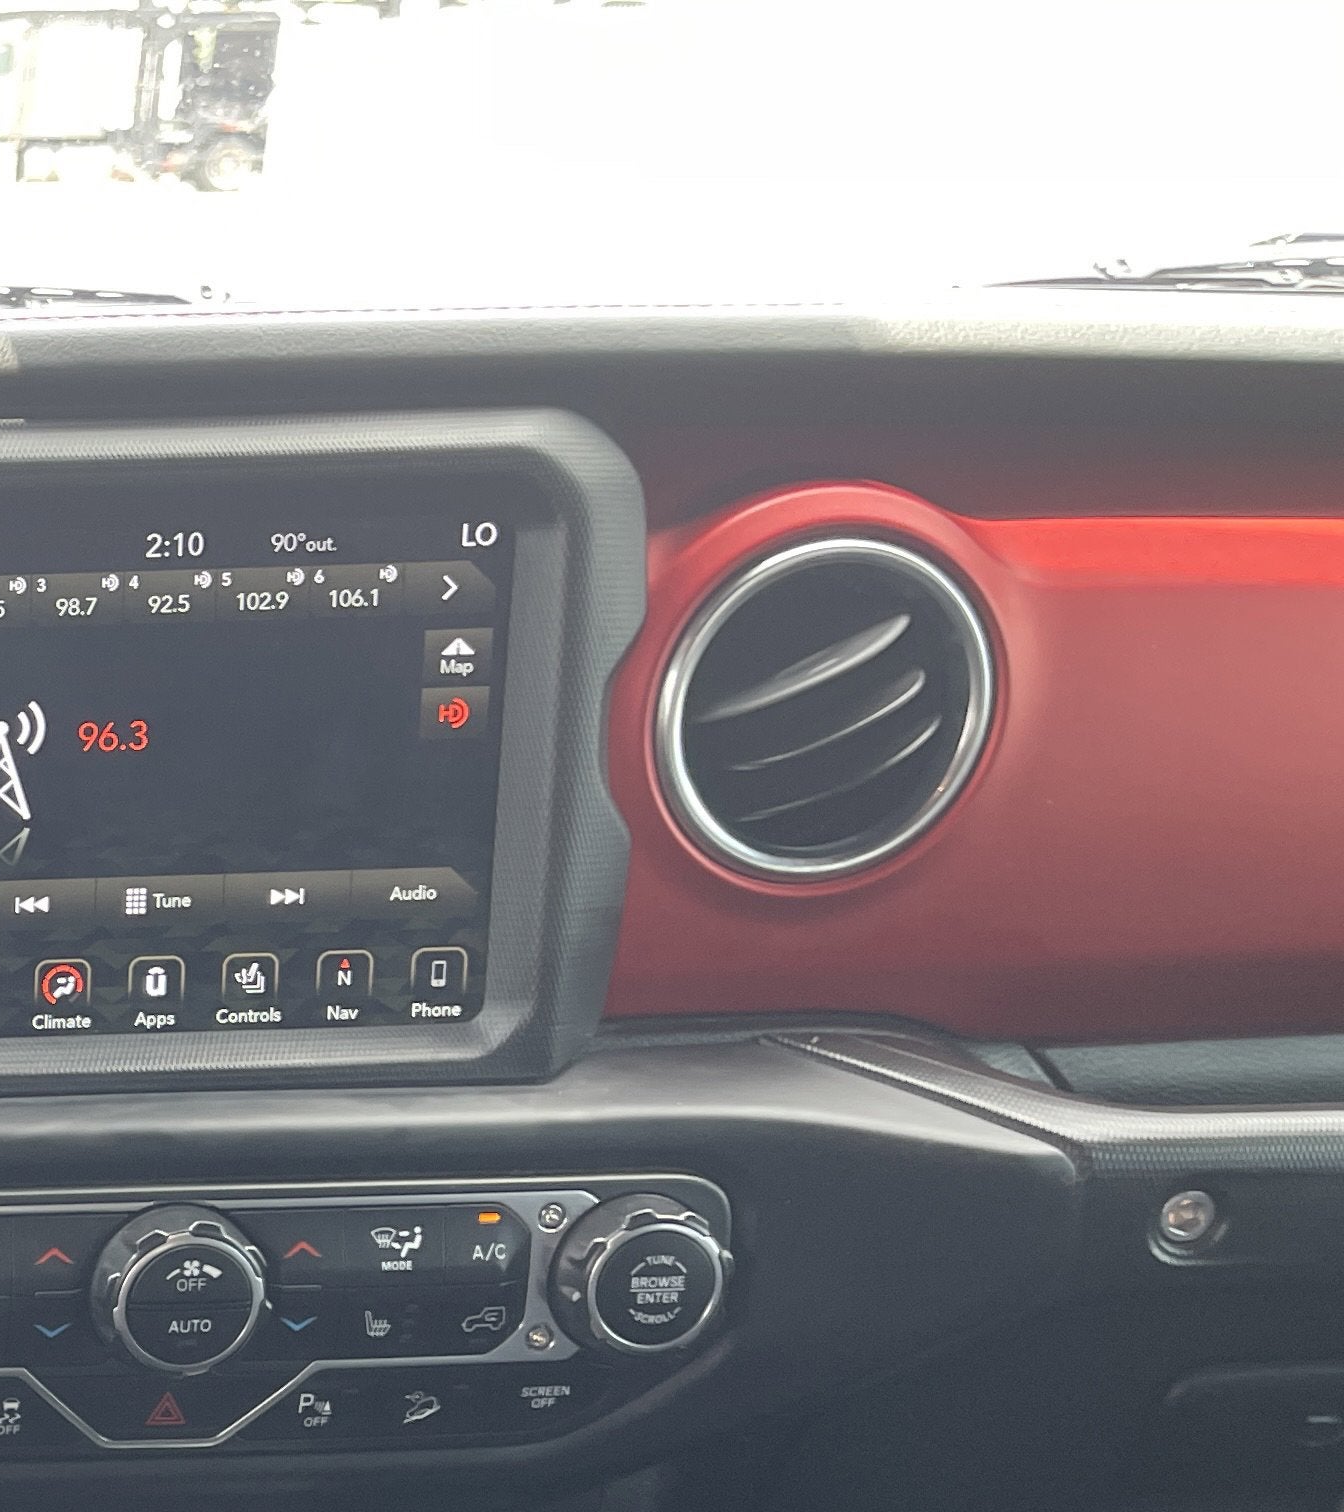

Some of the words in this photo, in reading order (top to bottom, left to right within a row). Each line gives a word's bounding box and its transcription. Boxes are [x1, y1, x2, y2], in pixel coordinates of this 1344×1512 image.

[462, 522, 498, 547] LO
[145, 532, 205, 558] 2:10
[128, 575, 139, 589] 4
[221, 572, 232, 587] 5
[314, 569, 325, 584] 6
[37, 579, 47, 592] 3
[147, 594, 190, 615] 92.5
[236, 591, 289, 610] 102.9
[329, 589, 379, 608] 106.1
[56, 597, 98, 616] 98.7
[440, 659, 475, 676] Map
[78, 720, 149, 753] 96.3
[390, 885, 437, 901] Audio
[153, 893, 192, 909] Tune
[215, 1007, 282, 1025] Controls
[327, 1006, 358, 1020] Nav
[411, 1003, 462, 1018] Phone
[32, 1014, 92, 1032] Climate
[135, 1012, 175, 1029] Apps
[472, 1243, 507, 1261] A/C
[381, 1260, 413, 1271] MODE
[646, 1255, 675, 1266] TUNE
[177, 1279, 207, 1292] OFF
[631, 1276, 685, 1288] BROWSE
[637, 1292, 678, 1304] ENTER
[634, 1312, 677, 1324] SCROLL
[169, 1319, 211, 1334] AUTO
[520, 1386, 571, 1397] SCREEN
[530, 1398, 556, 1409] OFF
[303, 1417, 328, 1427] OFF
